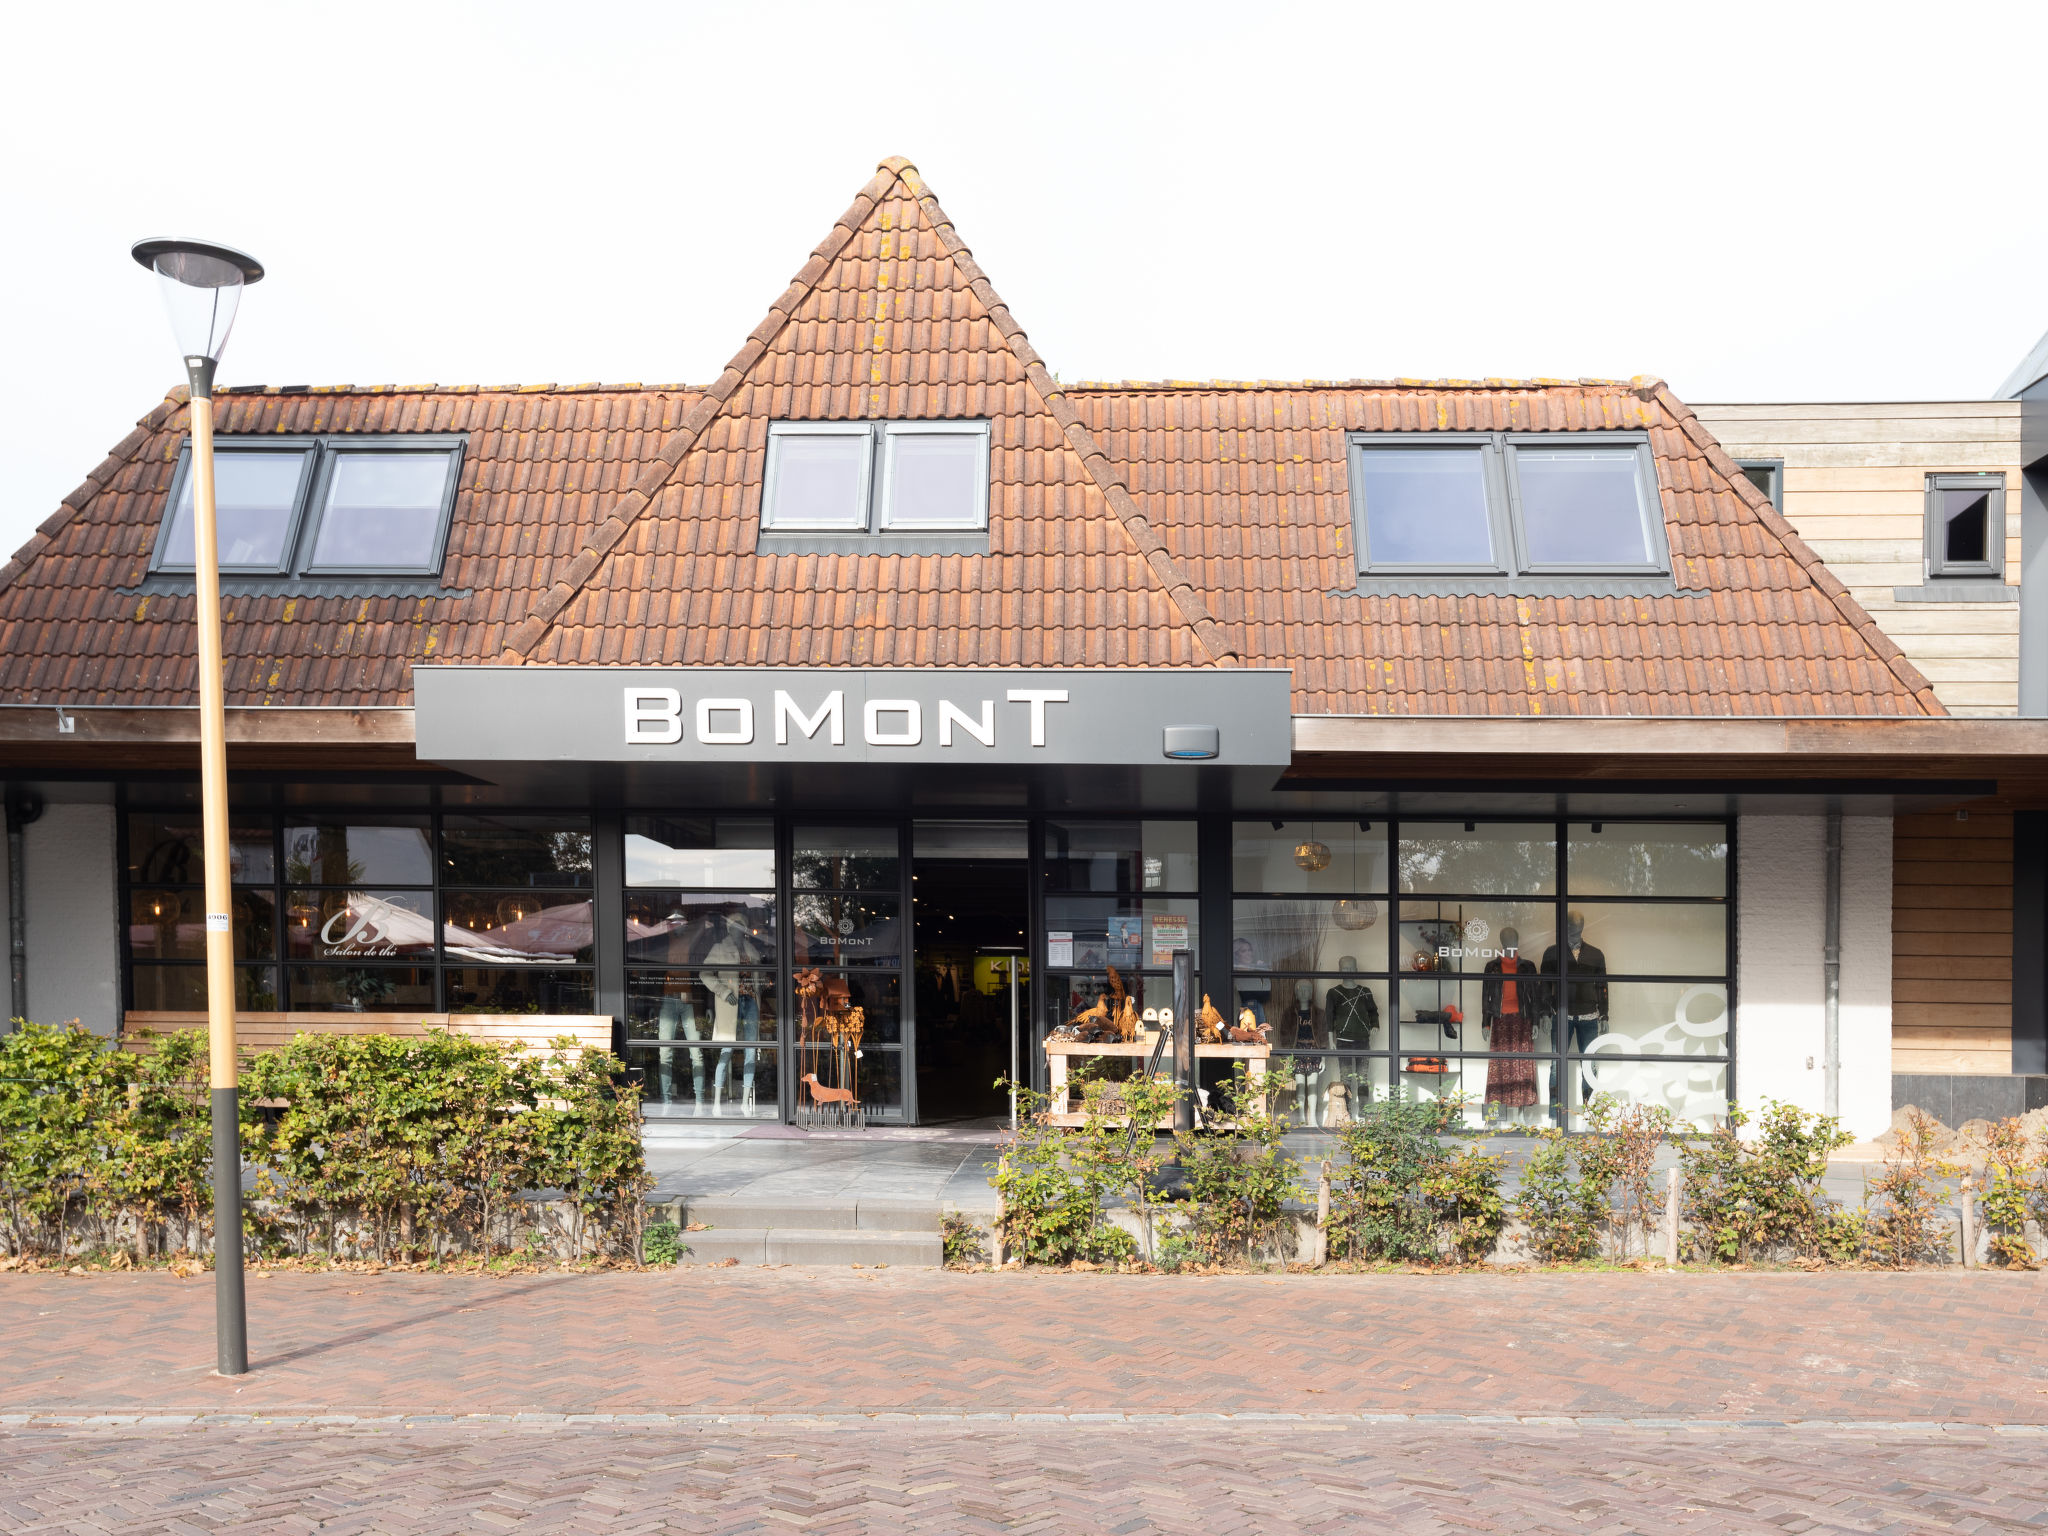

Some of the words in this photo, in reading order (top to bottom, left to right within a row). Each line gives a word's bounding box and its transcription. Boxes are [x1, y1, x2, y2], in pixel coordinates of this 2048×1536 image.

[623, 687, 1069, 747] BOMONT
[320, 895, 408, 945] B
[820, 936, 874, 945] BOMONT
[323, 943, 361, 957] Salon
[363, 945, 377, 957] de
[378, 943, 397, 957] thé
[1438, 945, 1518, 958] BOMONT
[991, 960, 1030, 973] KID
